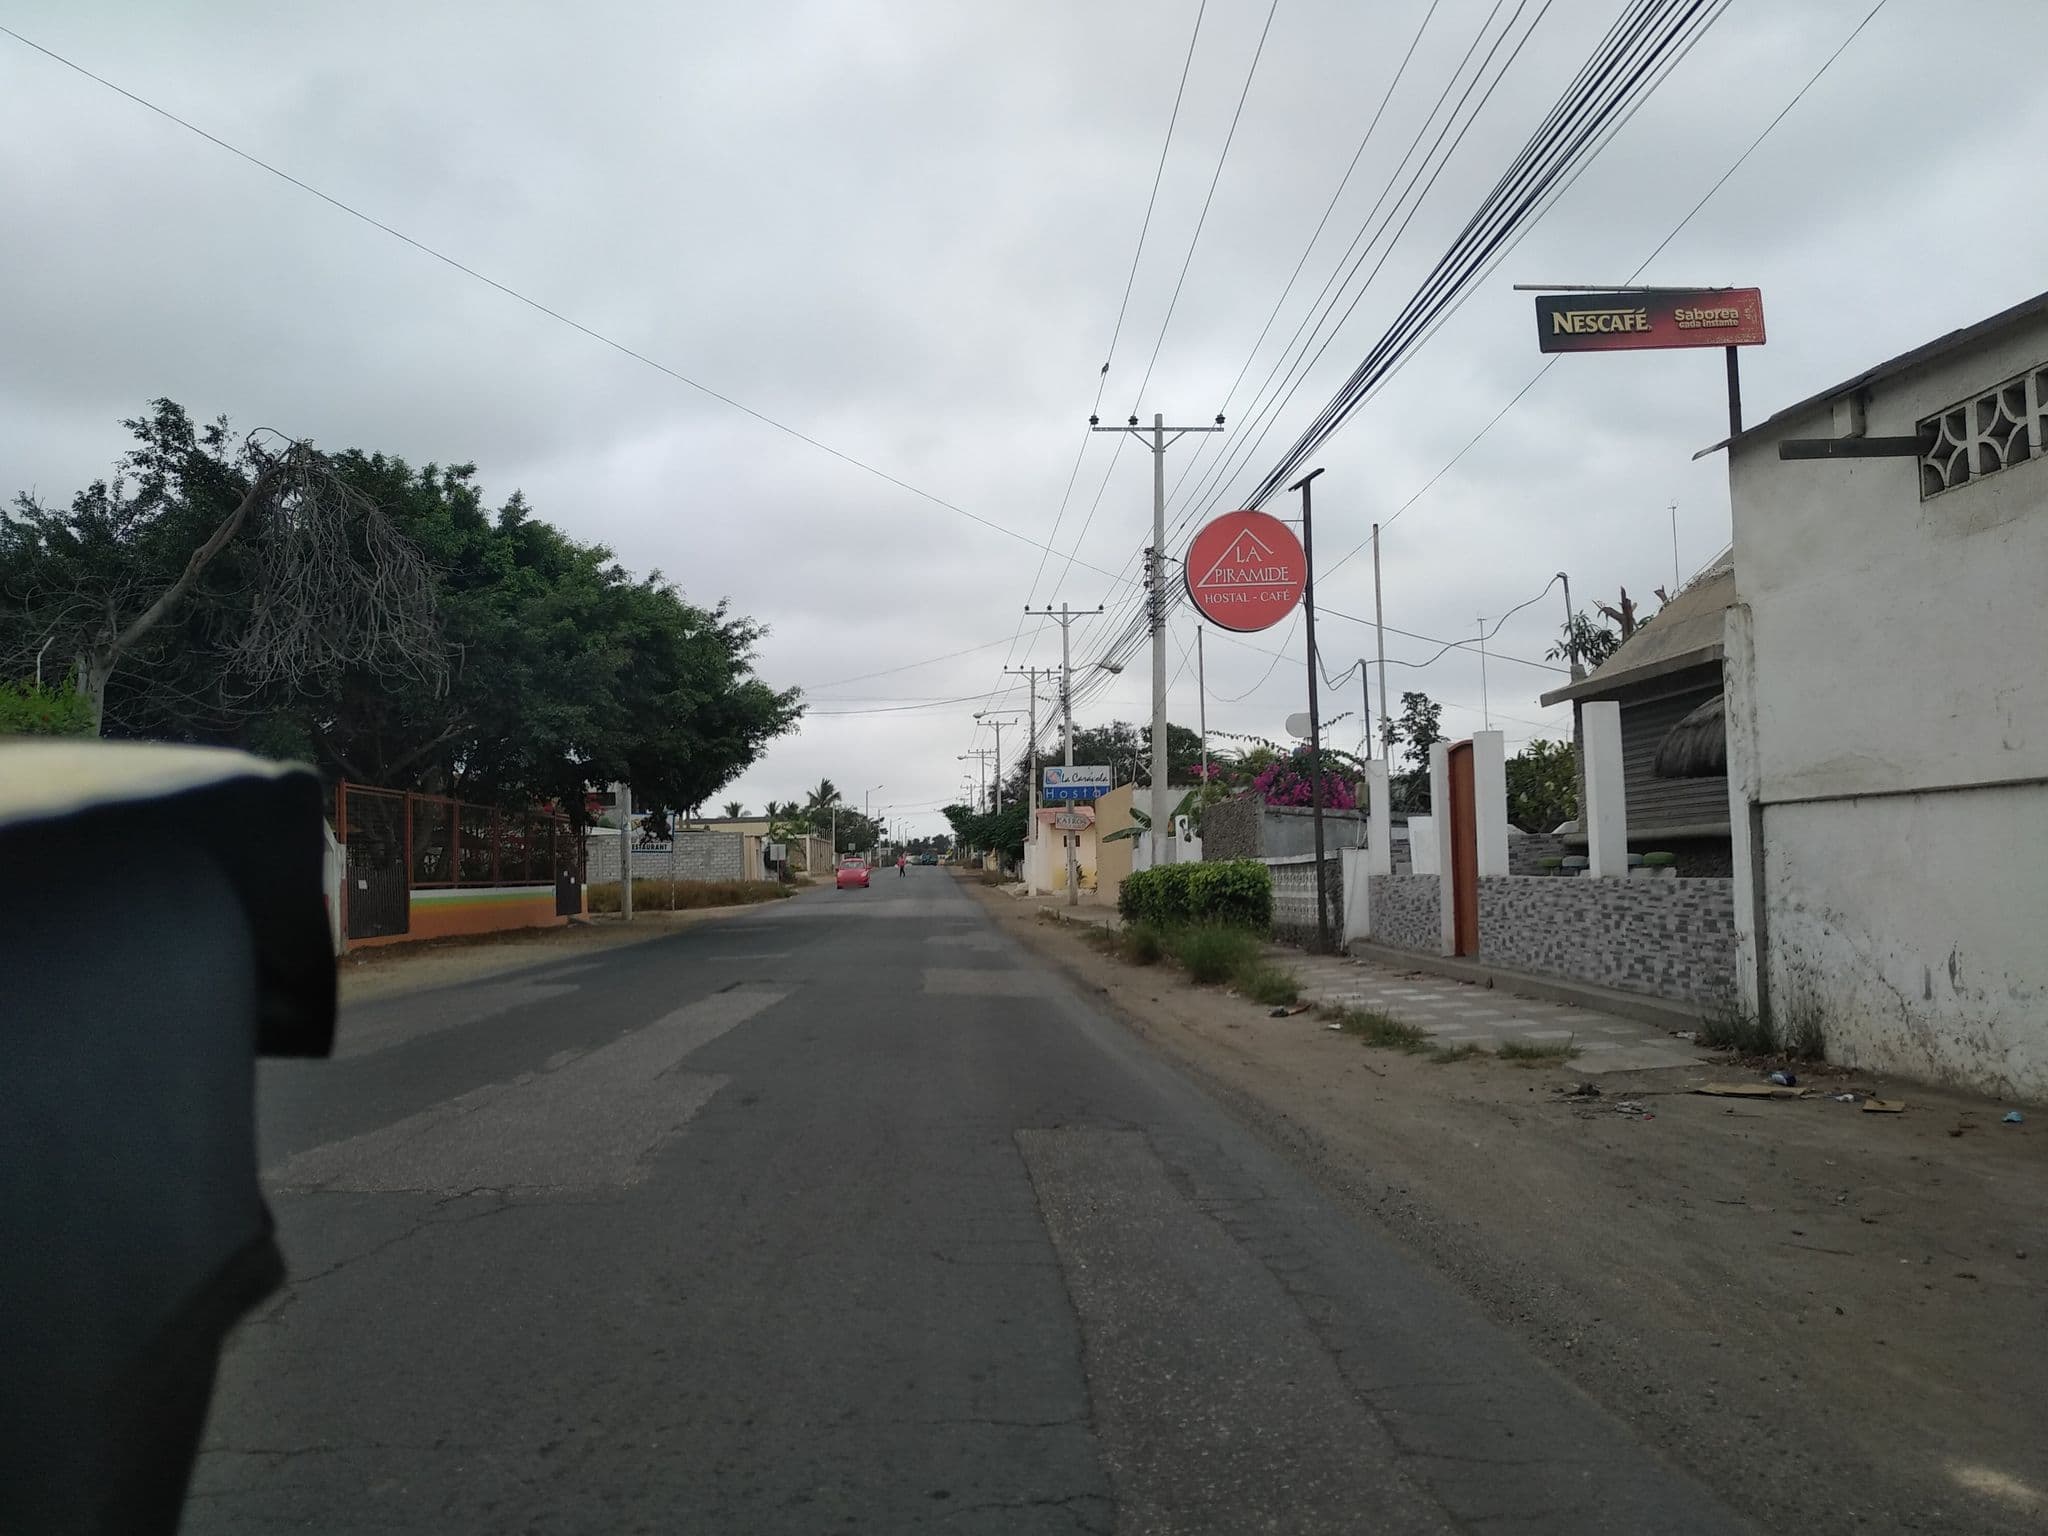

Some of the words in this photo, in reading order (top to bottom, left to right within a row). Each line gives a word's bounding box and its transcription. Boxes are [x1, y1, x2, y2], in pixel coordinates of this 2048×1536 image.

[1552, 307, 1650, 334] NESCAFÉ
[1674, 308, 1739, 321] Saborea
[1678, 319, 1702, 329] cada
[1702, 318, 1739, 328] instante
[1236, 546, 1263, 563] LA
[1214, 566, 1289, 583] PIRAMIDE
[1204, 592, 1250, 604] HOSTAL
[1260, 588, 1291, 602] CAFÉ
